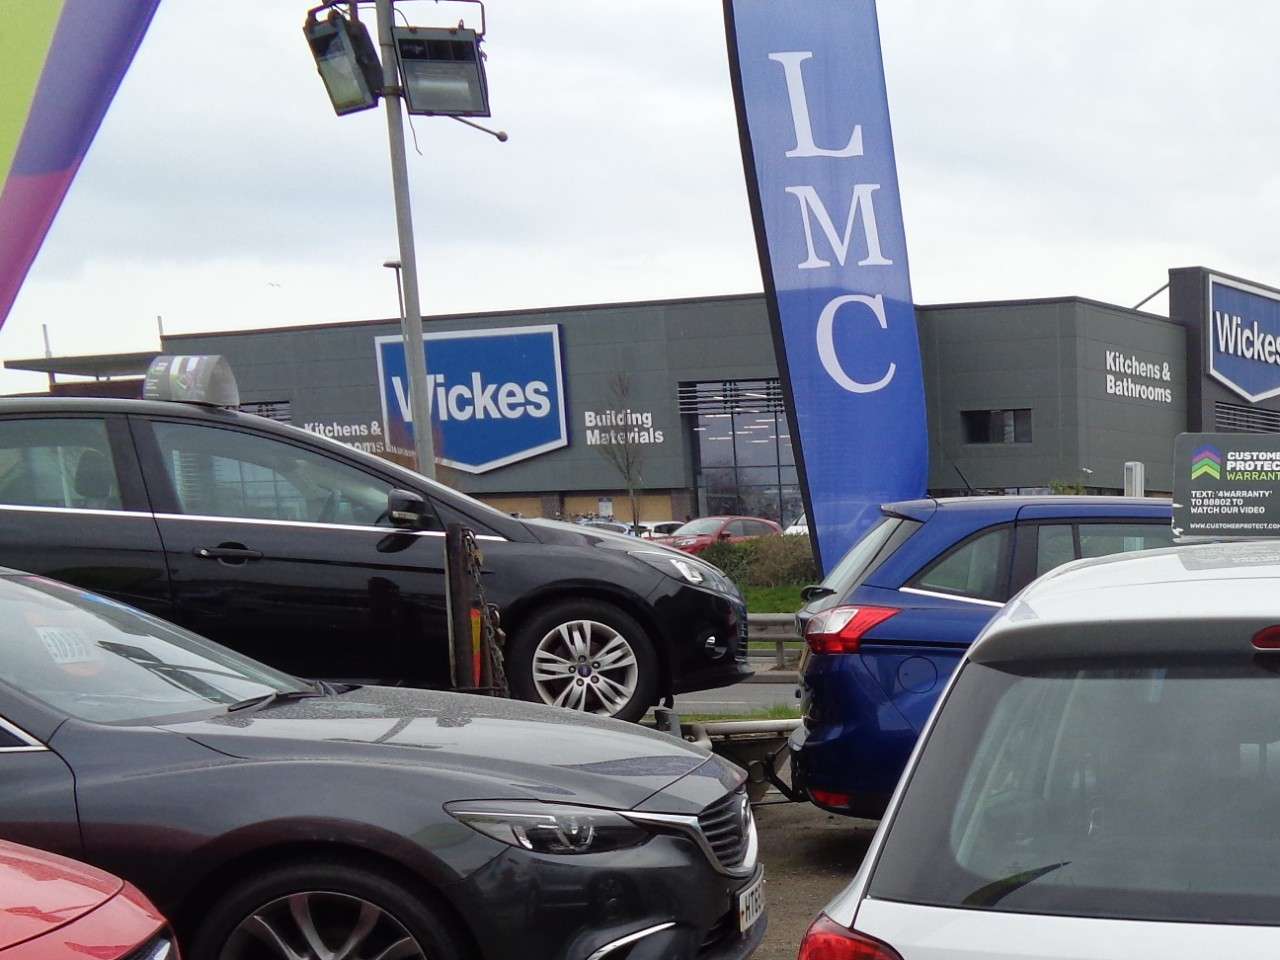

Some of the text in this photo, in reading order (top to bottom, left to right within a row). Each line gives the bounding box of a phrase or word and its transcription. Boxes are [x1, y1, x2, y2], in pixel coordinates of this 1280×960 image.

[768, 50, 897, 394] LMC
[1105, 350, 1171, 381] Kitchens &
[1106, 374, 1172, 403] Bathrooms
[370, 420, 382, 435] &
[584, 410, 653, 428] Building
[586, 427, 664, 446] Materials
[1191, 490, 1215, 498] TEXT:
[1190, 506, 1219, 514] WATCH
